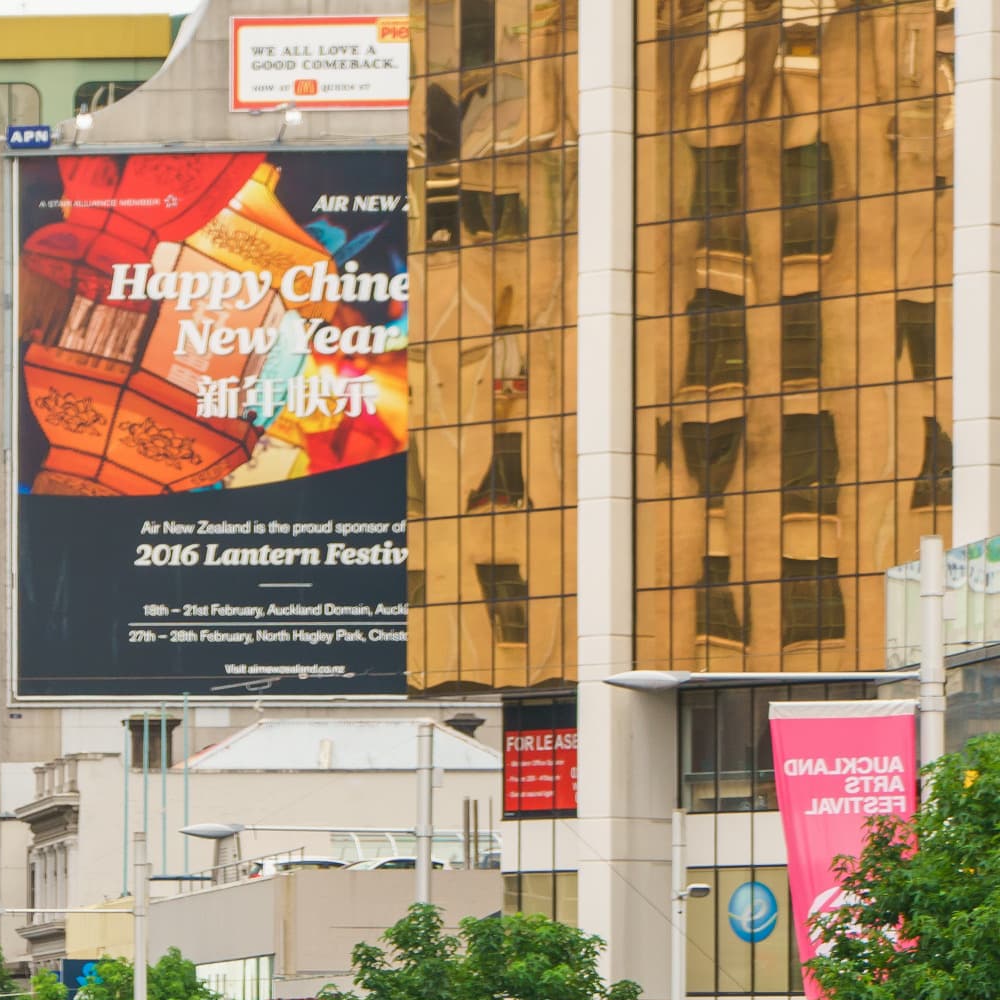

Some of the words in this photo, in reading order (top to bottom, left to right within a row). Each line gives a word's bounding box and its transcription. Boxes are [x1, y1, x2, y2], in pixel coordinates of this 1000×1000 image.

[252, 46, 276, 56] WE
[283, 46, 312, 56] ALL
[319, 45, 359, 55] LOVE
[367, 45, 376, 54] A
[252, 61, 296, 71] GOOD
[303, 59, 398, 71] COMEBACK.
[10, 130, 49, 144] APN
[47, 199, 71, 208] STAR
[73, 198, 116, 207] ALLIANCE
[119, 198, 160, 207] MEMBER
[312, 193, 349, 213] AIR
[352, 194, 401, 212] NEW
[107, 263, 272, 311] Happy
[280, 260, 409, 302] Chine
[174, 318, 279, 355] New
[292, 318, 399, 355] Year
[196, 373, 379, 419] 新年快乐
[141, 520, 161, 535] Air
[163, 520, 195, 535] New
[197, 519, 251, 535] Zealand
[254, 519, 266, 534] is
[269, 519, 290, 534] the
[293, 519, 333, 537] proud
[335, 521, 388, 536] sponsor
[392, 518, 407, 533] of
[134, 543, 200, 567] 2016
[203, 543, 321, 566] Lantern
[324, 540, 408, 566] Festiv
[143, 603, 169, 617] 18th
[183, 603, 209, 617] 21st
[211, 603, 265, 620] February,
[267, 602, 322, 616] Auckland
[324, 602, 373, 617] Domain,
[128, 629, 156, 643] 27th
[169, 629, 198, 643] 28th
[200, 629, 254, 646] February,
[256, 629, 290, 643] North
[293, 628, 334, 645] Hagley
[336, 628, 367, 643] Park,
[224, 663, 247, 675] Visit
[506, 735, 535, 752] FOR
[536, 732, 578, 751] LEASE
